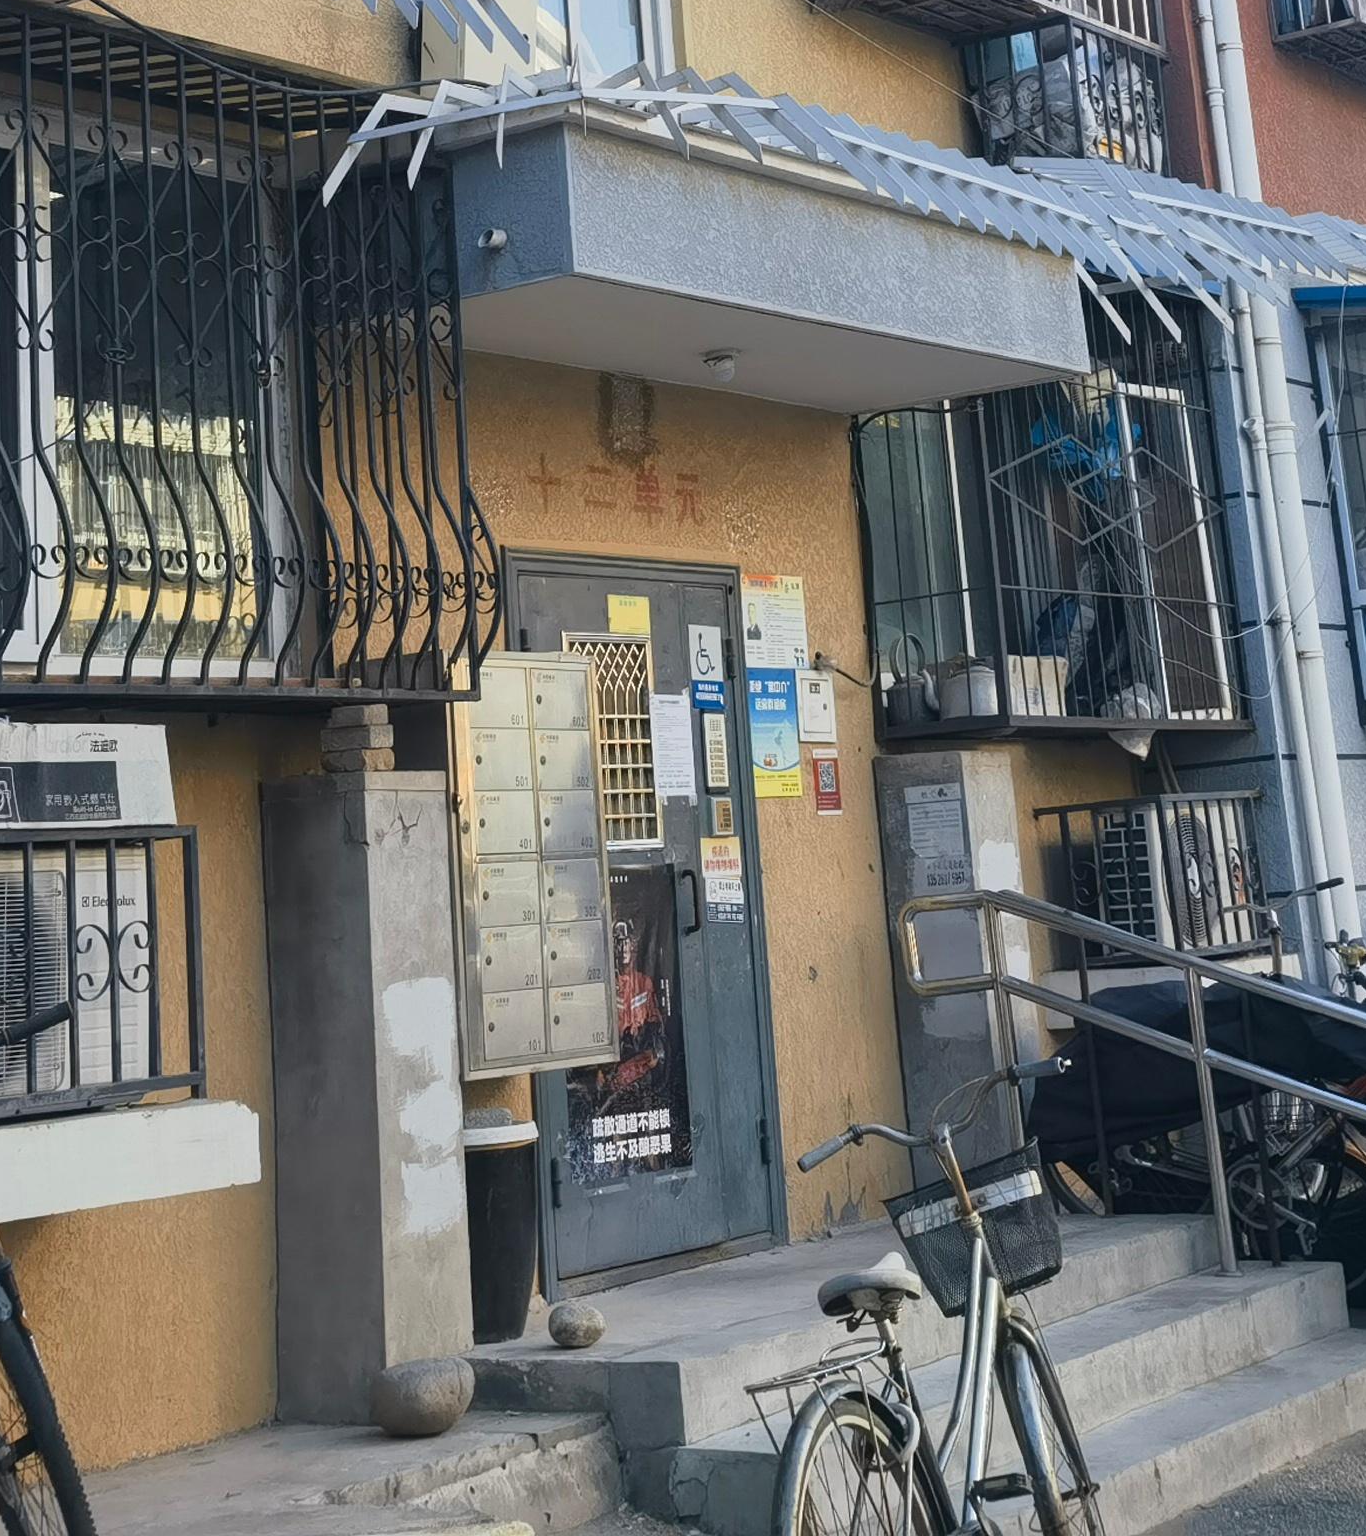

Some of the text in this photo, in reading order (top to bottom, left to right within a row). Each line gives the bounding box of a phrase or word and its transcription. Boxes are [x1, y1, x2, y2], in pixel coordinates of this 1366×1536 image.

[511, 714, 524, 726] 601
[572, 716, 585, 728] 602
[515, 776, 528, 788] 501
[576, 776, 590, 788] 502
[519, 839, 532, 850] 401
[92, 895, 136, 906] Eleolux
[523, 910, 536, 922] 301
[525, 974, 539, 986] 201
[592, 1032, 605, 1044] 102
[528, 1040, 542, 1052] 101
[592, 1108, 671, 1138] 疏散通道不能锁
[593, 1133, 672, 1165] 逃生不及酿恶果
